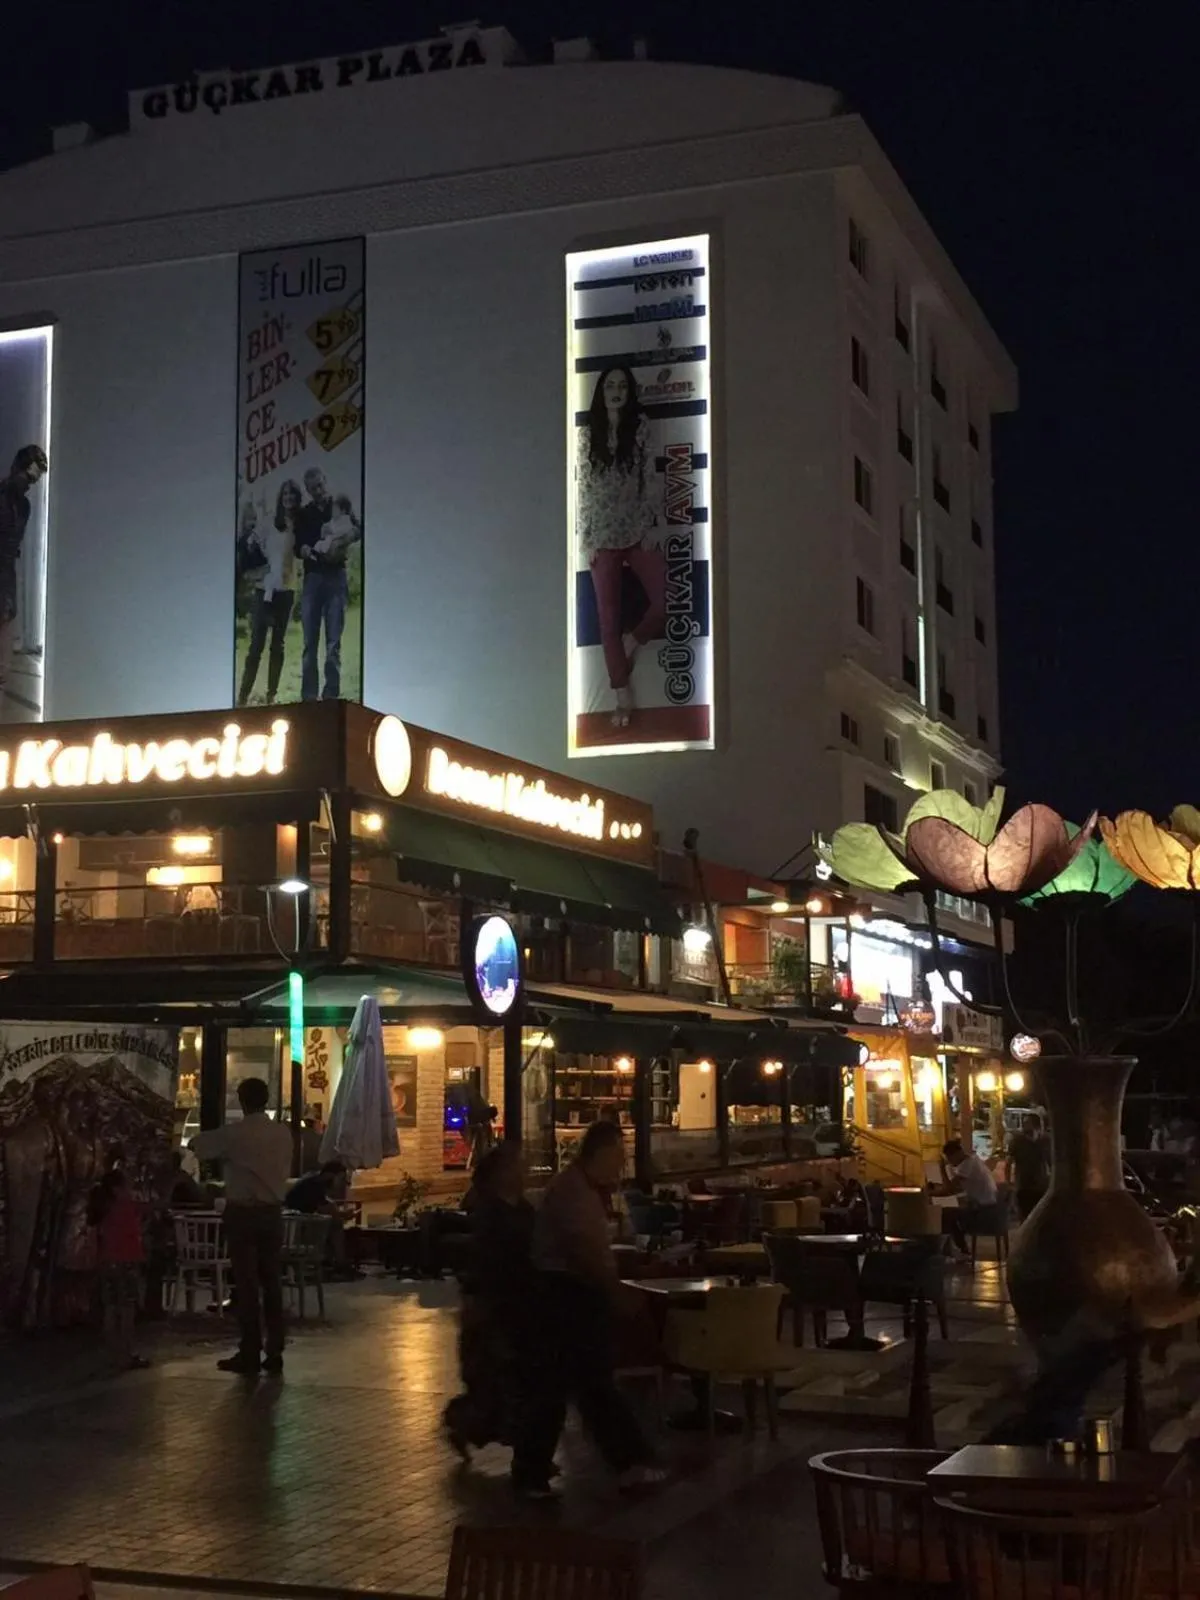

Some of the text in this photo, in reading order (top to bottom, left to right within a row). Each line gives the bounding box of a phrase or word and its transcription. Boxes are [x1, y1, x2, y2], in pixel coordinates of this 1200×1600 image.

[143, 38, 487, 119] GÜÇKAR PLAZA
[271, 257, 346, 300] fulla
[245, 420, 308, 484] ÜRÜN
[246, 400, 276, 442] CE
[658, 442, 701, 705] GÜÇKAR AVM
[13, 719, 289, 788] Kahvecisi
